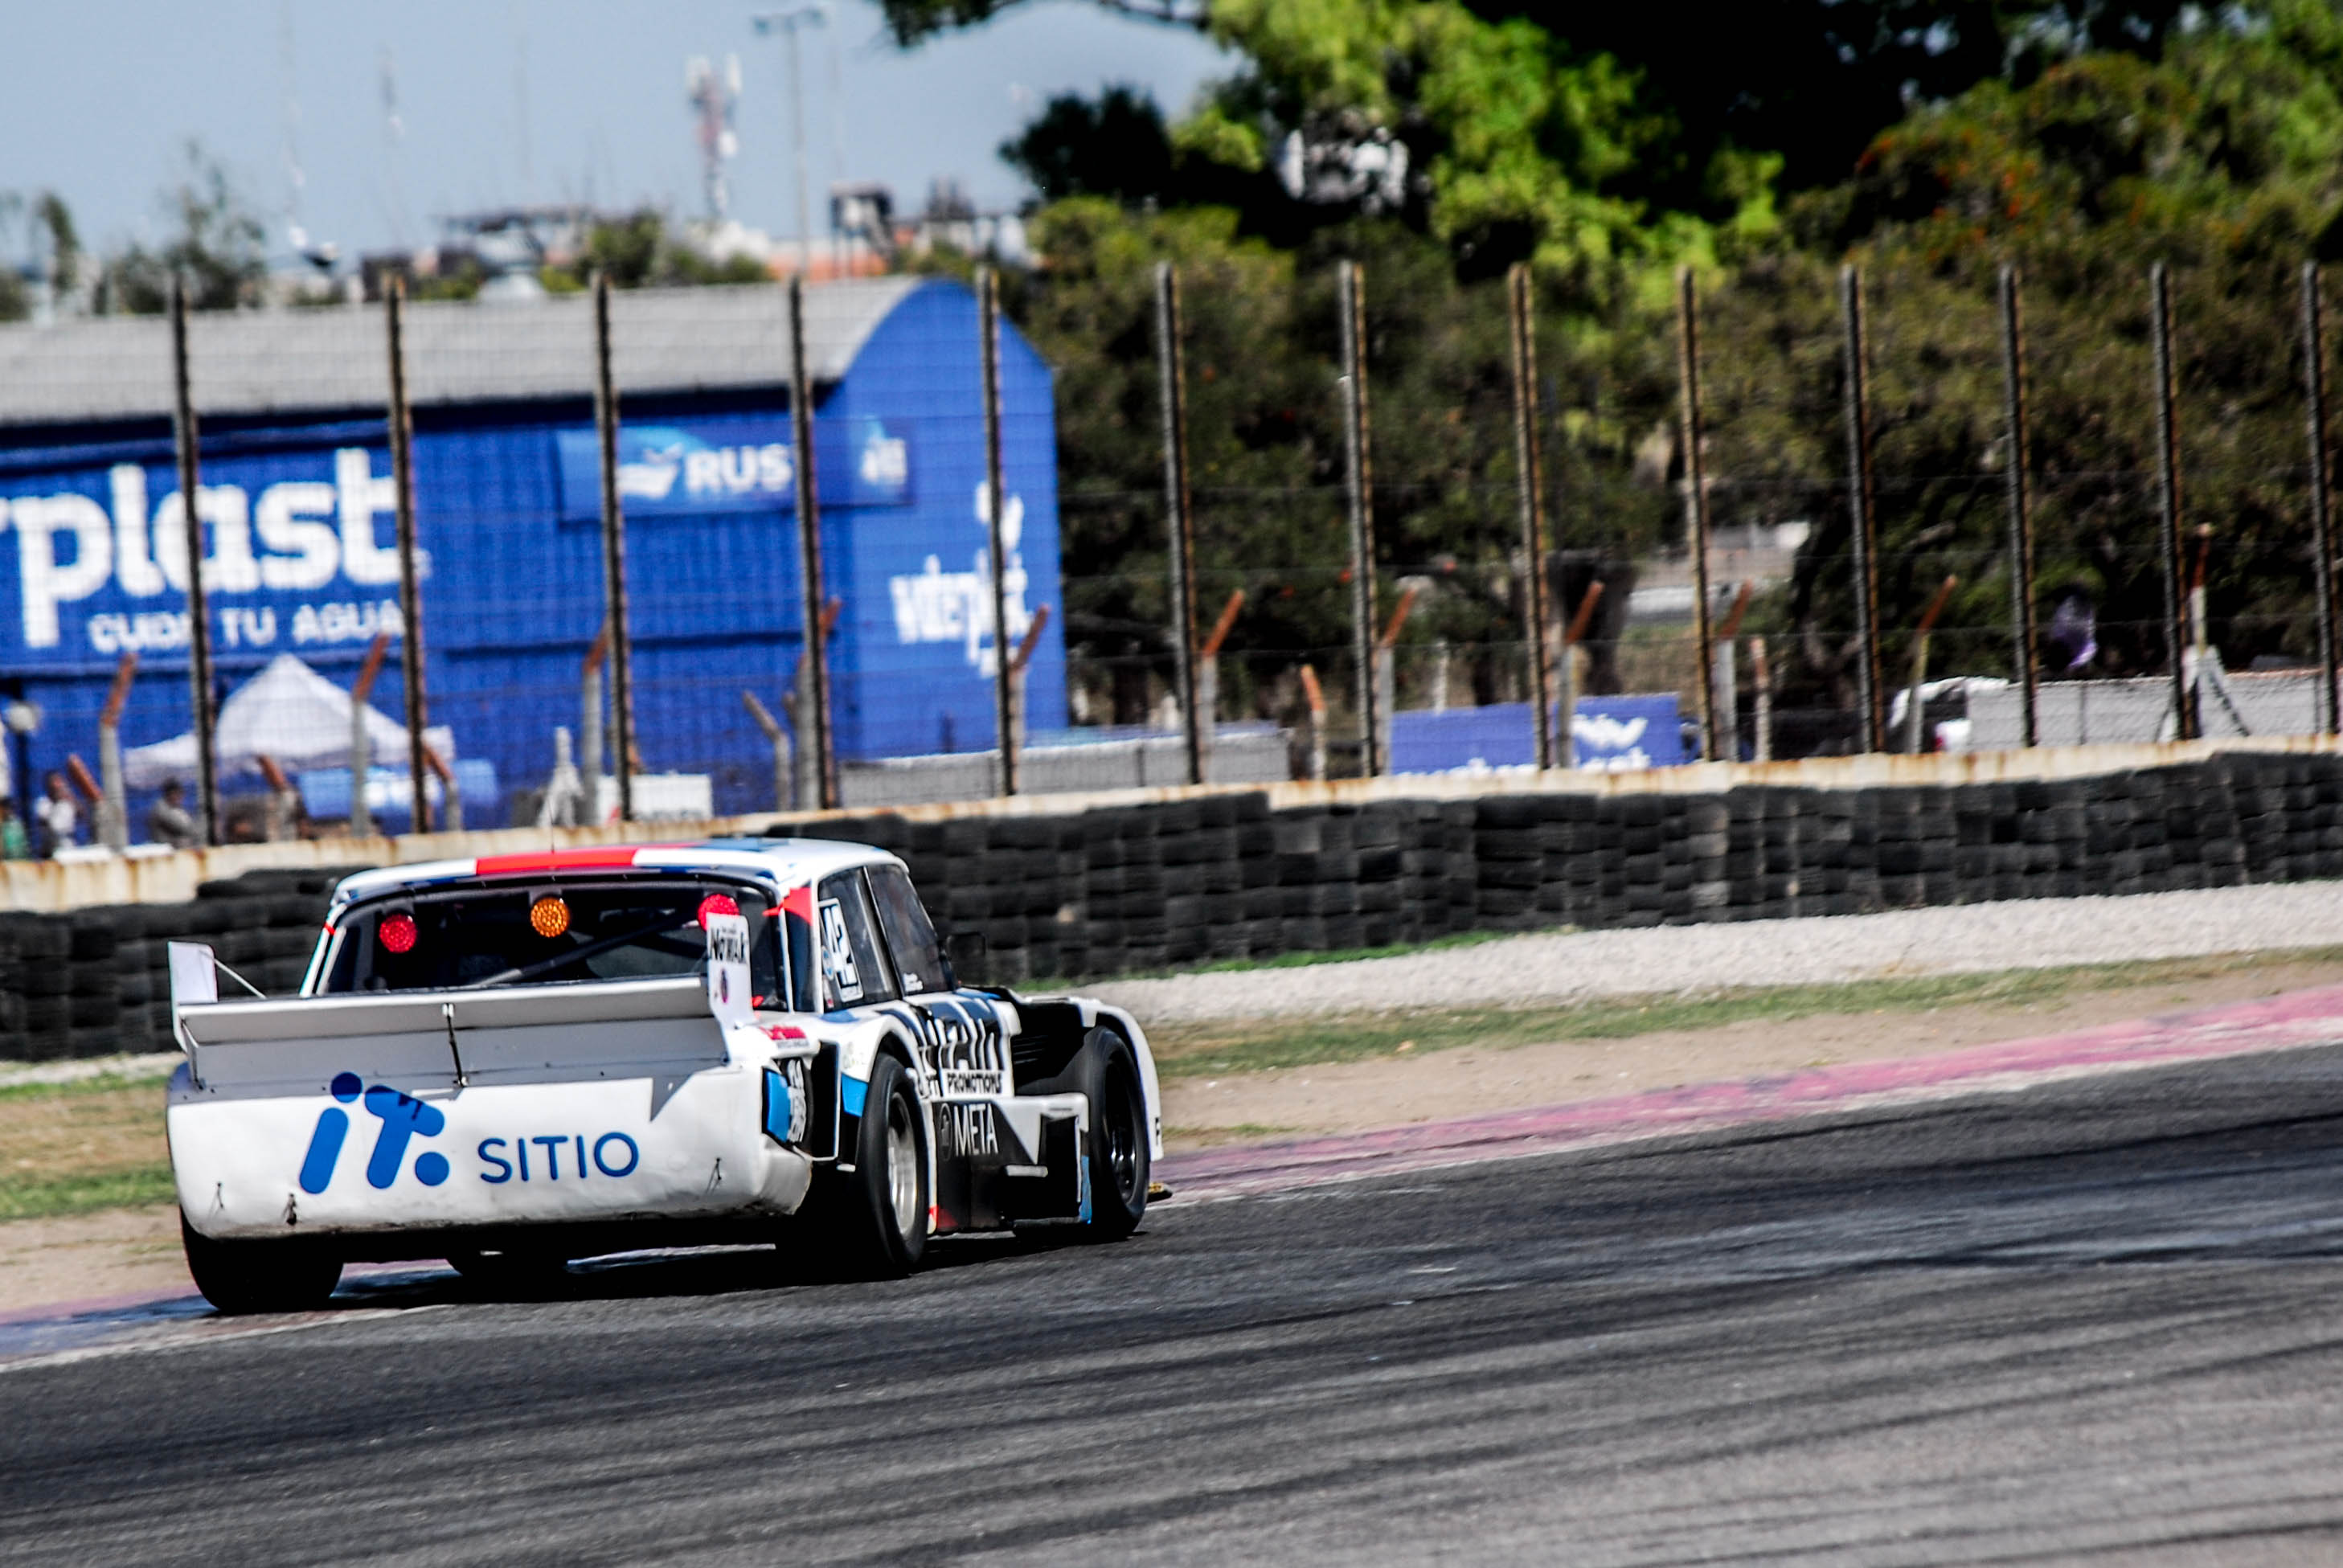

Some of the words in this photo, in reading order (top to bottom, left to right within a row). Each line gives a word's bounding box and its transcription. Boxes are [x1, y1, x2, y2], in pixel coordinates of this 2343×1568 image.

[686, 443, 793, 493] RUS
[0, 448, 402, 648] plast
[219, 605, 276, 646] TU
[292, 600, 406, 644] AGUA
[953, 1103, 998, 1157] META
[478, 1131, 640, 1184] SITIO
